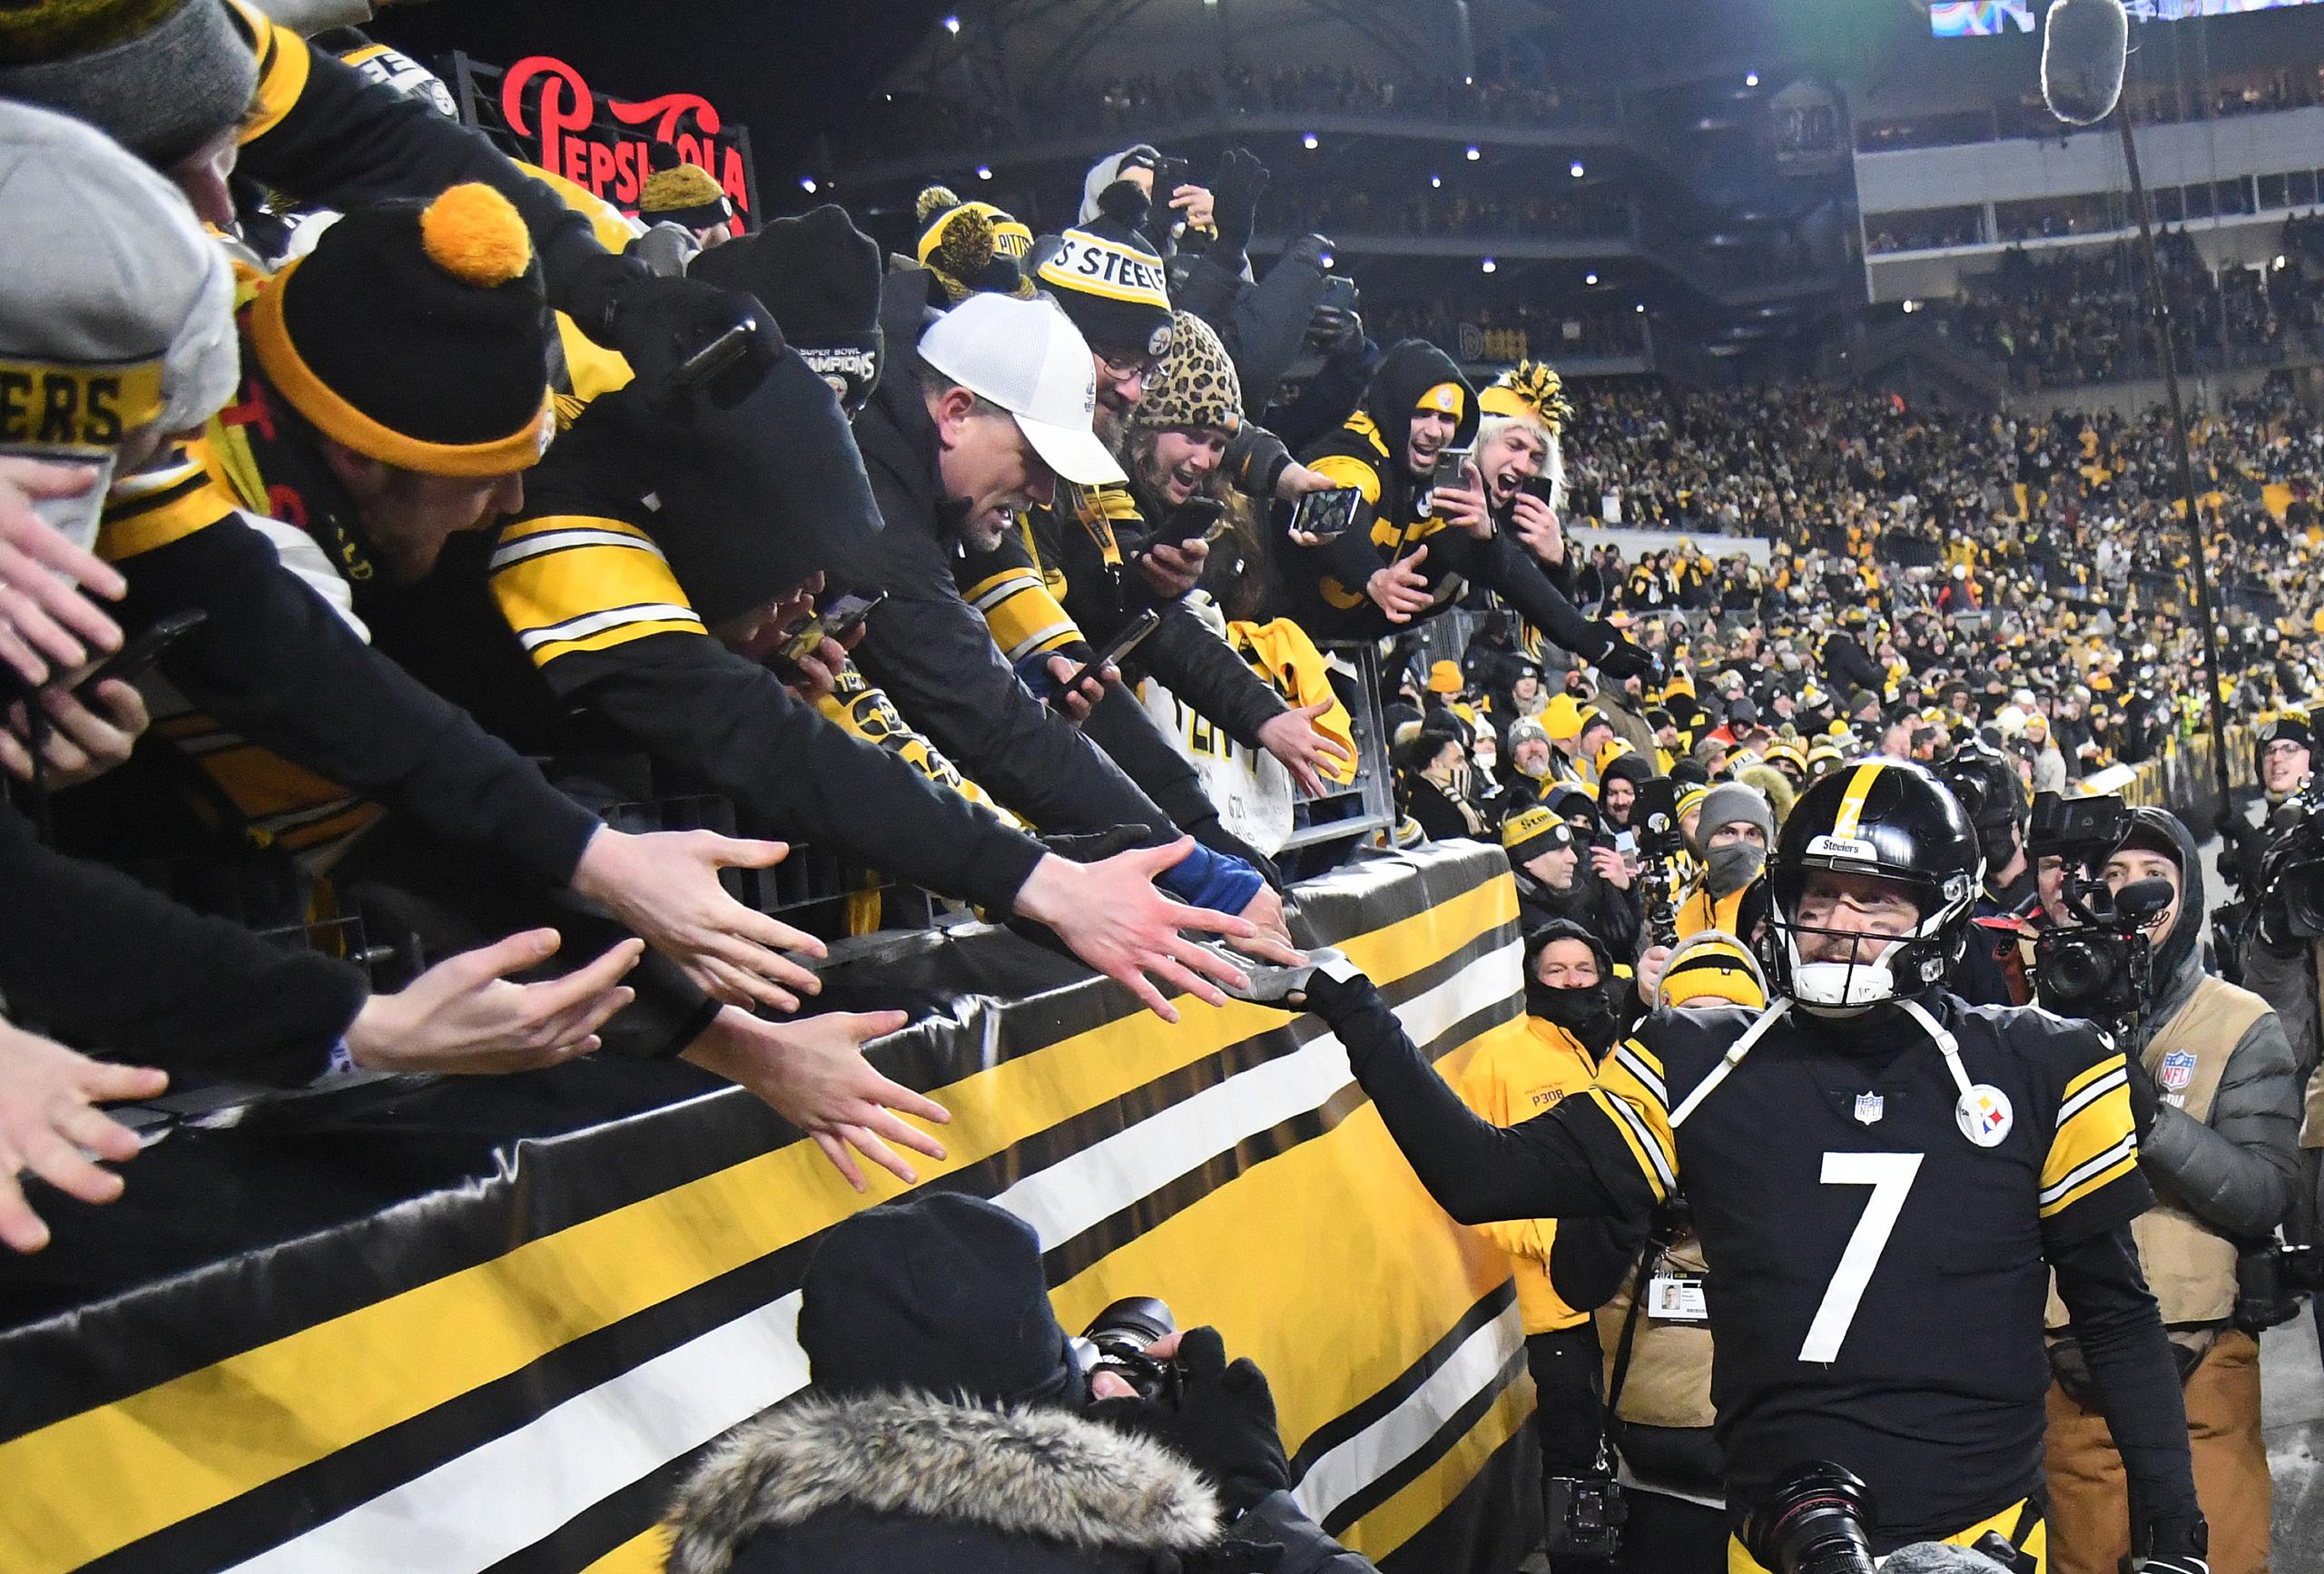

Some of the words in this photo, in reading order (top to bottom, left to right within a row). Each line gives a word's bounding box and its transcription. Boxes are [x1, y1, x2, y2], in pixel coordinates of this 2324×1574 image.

[800, 349, 831, 357] SUPER
[833, 347, 862, 357] BOWL
[1823, 839, 1859, 854] Steelers
[2164, 1067, 2187, 1084] NFL
[1532, 1088, 1565, 1107] P308
[1797, 1152, 1925, 1363] 7
